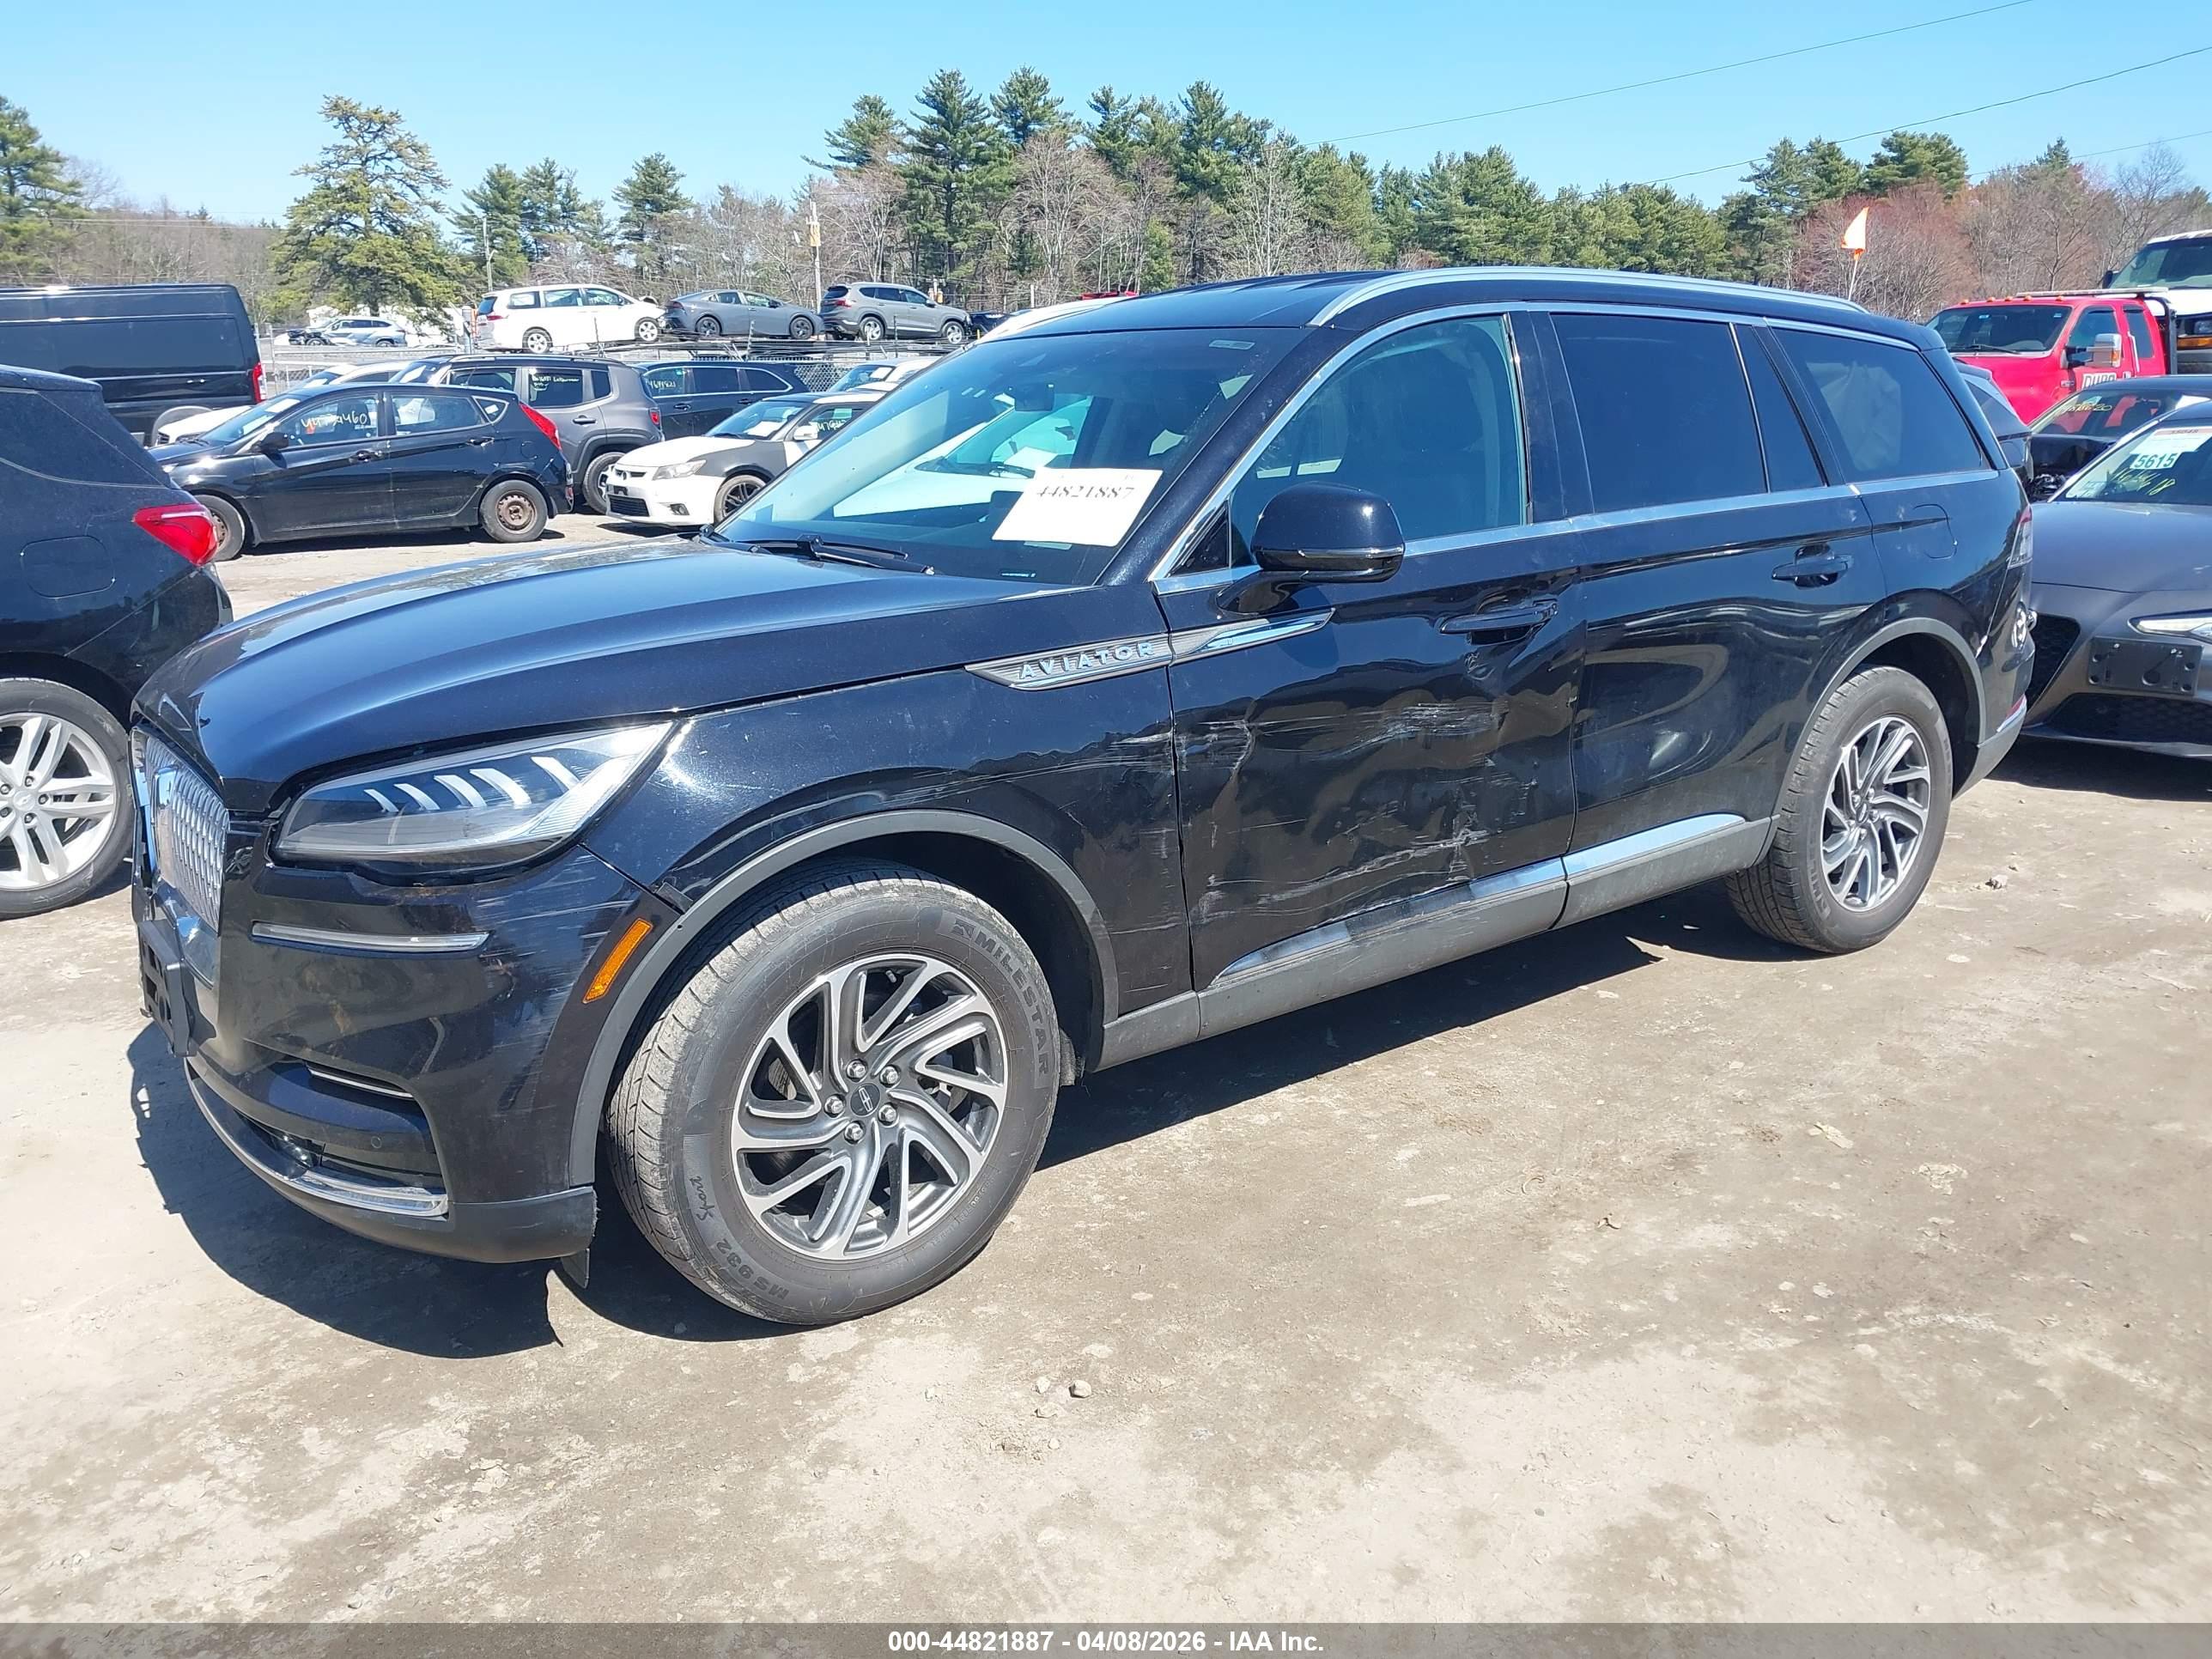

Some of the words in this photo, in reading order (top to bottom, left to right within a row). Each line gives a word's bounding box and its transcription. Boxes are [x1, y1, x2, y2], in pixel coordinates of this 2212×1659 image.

[2134, 453, 2178, 468] 5615
[1037, 486, 1134, 499] 44821887
[1019, 641, 1155, 679] AVIATOR
[974, 932, 1048, 1073] MILESTAR
[690, 1176, 715, 1221] Sport
[716, 1238, 789, 1299] MS932
